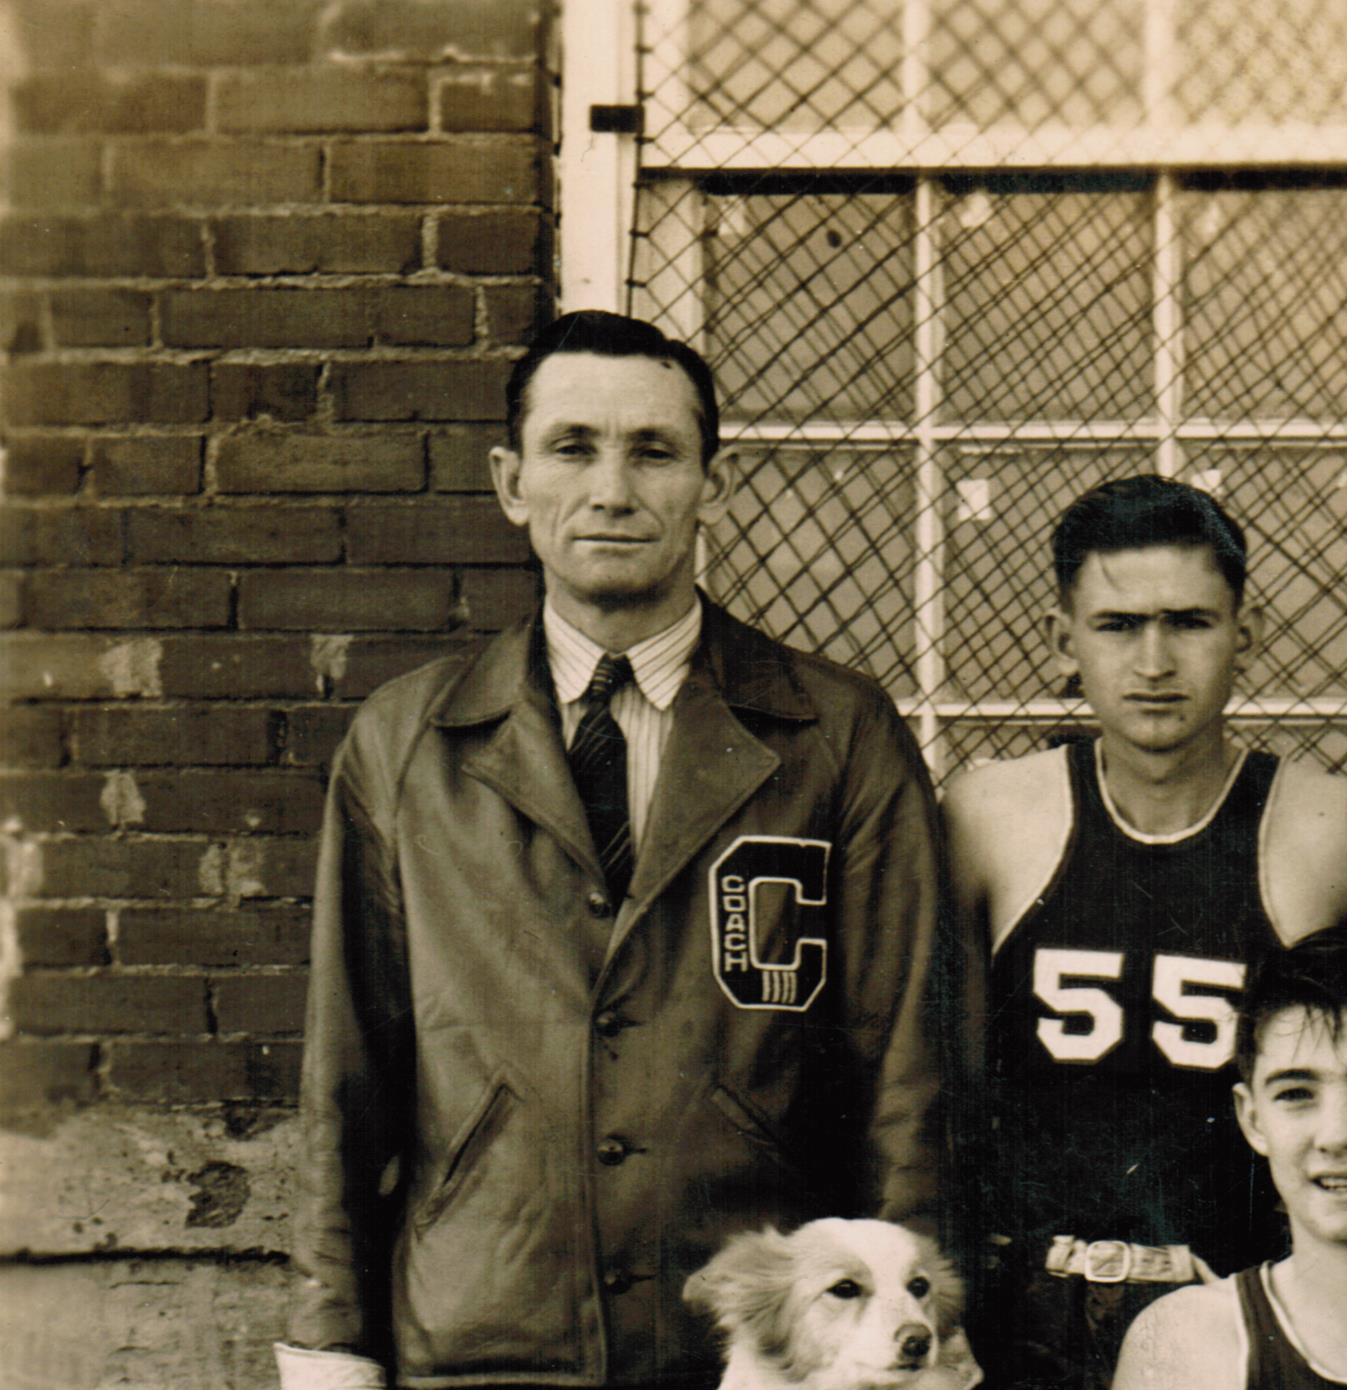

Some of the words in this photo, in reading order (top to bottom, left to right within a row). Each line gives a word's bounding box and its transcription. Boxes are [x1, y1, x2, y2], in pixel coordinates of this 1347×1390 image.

[709, 835, 831, 1012] C
[721, 875, 748, 973] COACH
[1033, 948, 1247, 1071] 55
